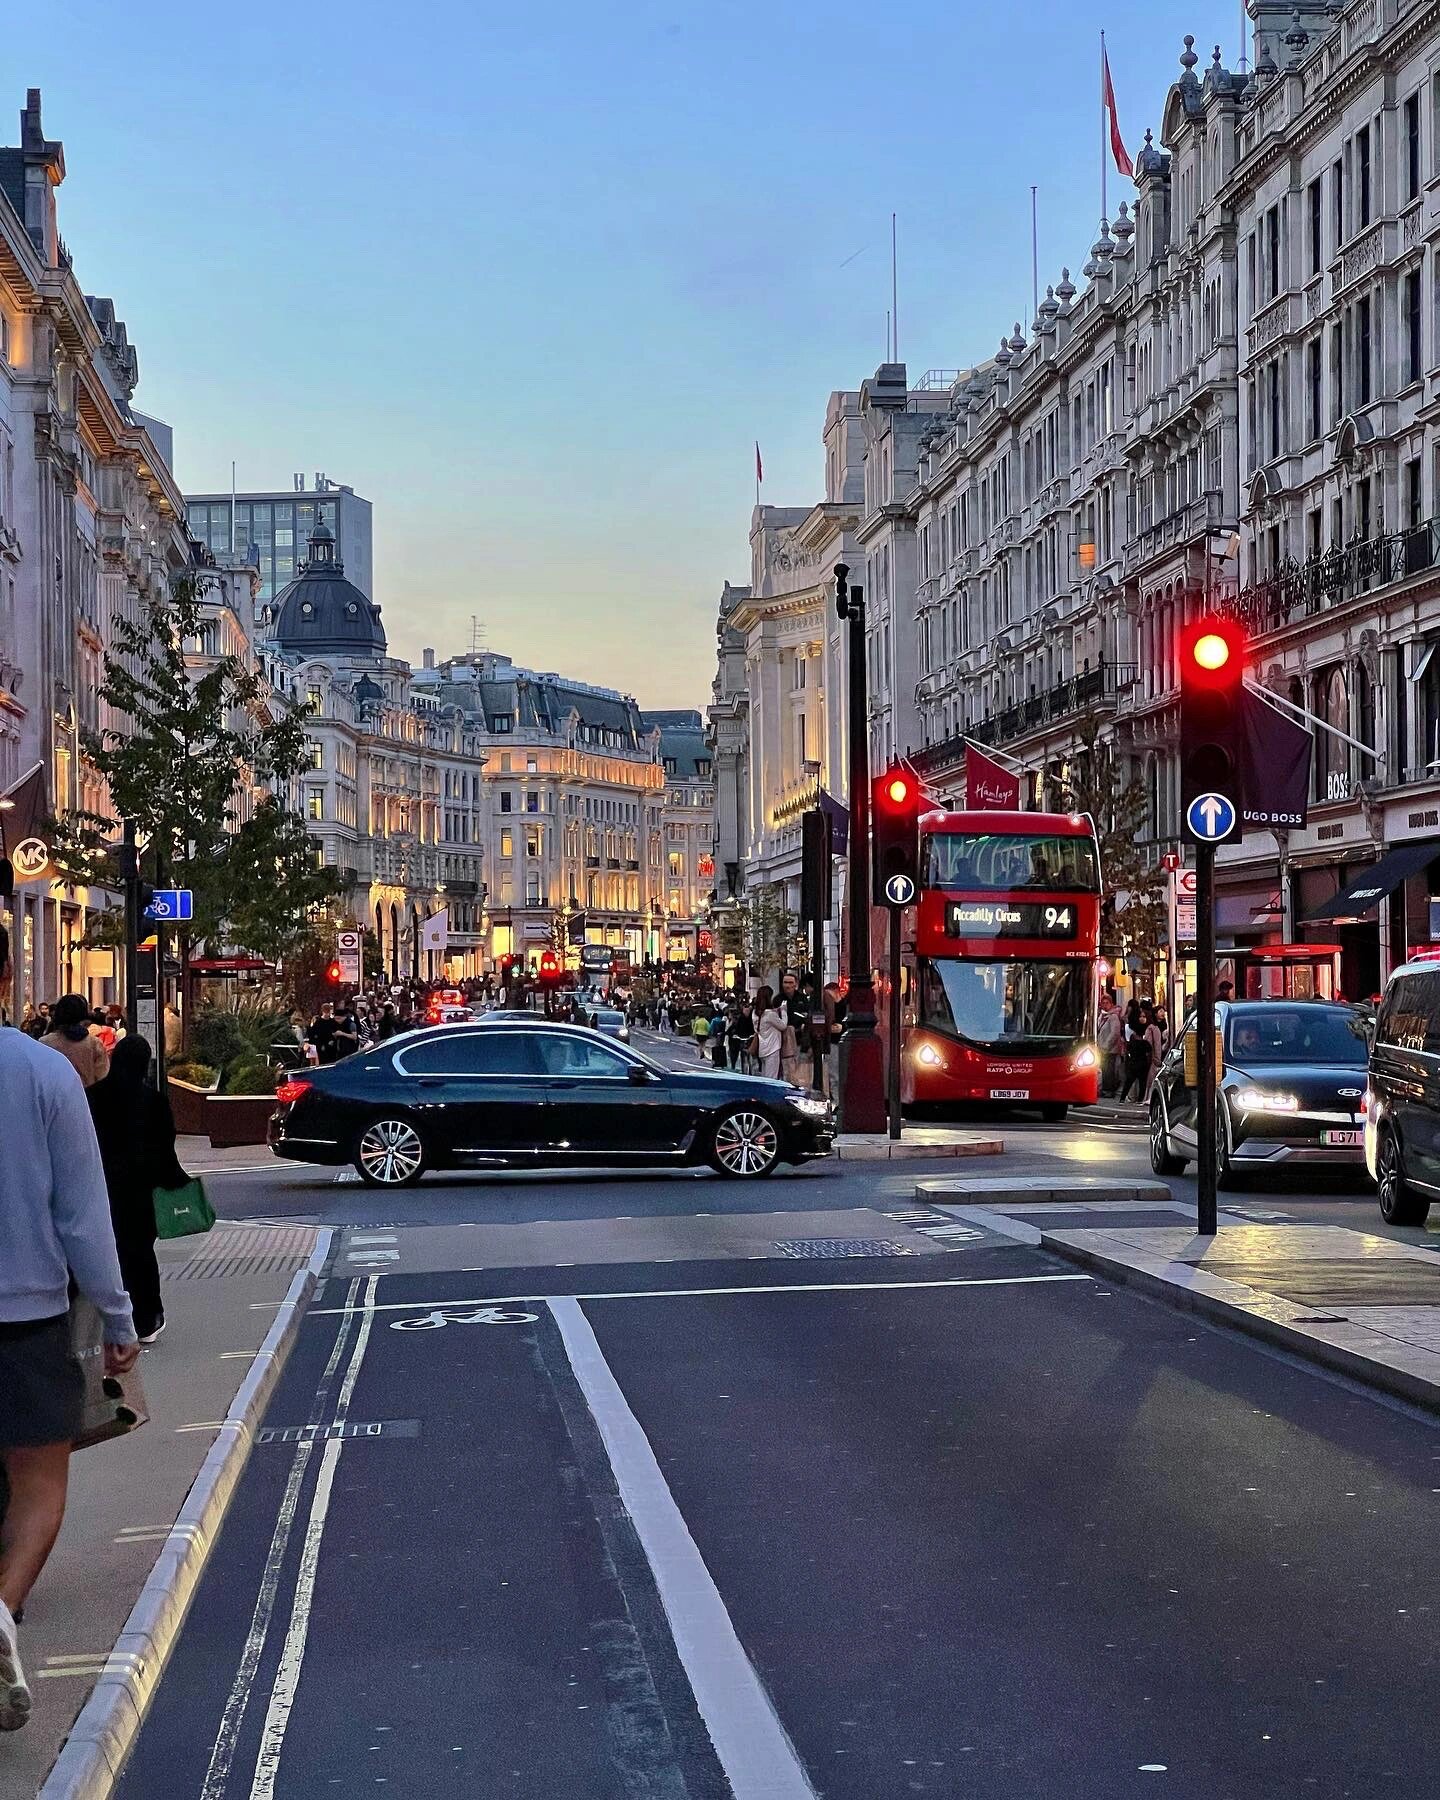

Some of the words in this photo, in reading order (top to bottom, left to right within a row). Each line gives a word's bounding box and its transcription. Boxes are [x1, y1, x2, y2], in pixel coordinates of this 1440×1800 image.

[975, 780, 1013, 804] Hamleys
[1243, 810, 1268, 822] UGO
[1271, 813, 1302, 823] BOSS
[1167, 854, 1176, 868] T
[953, 907, 993, 925] Piccadilly
[995, 908, 1021, 923] Circus
[1044, 908, 1070, 928] 94
